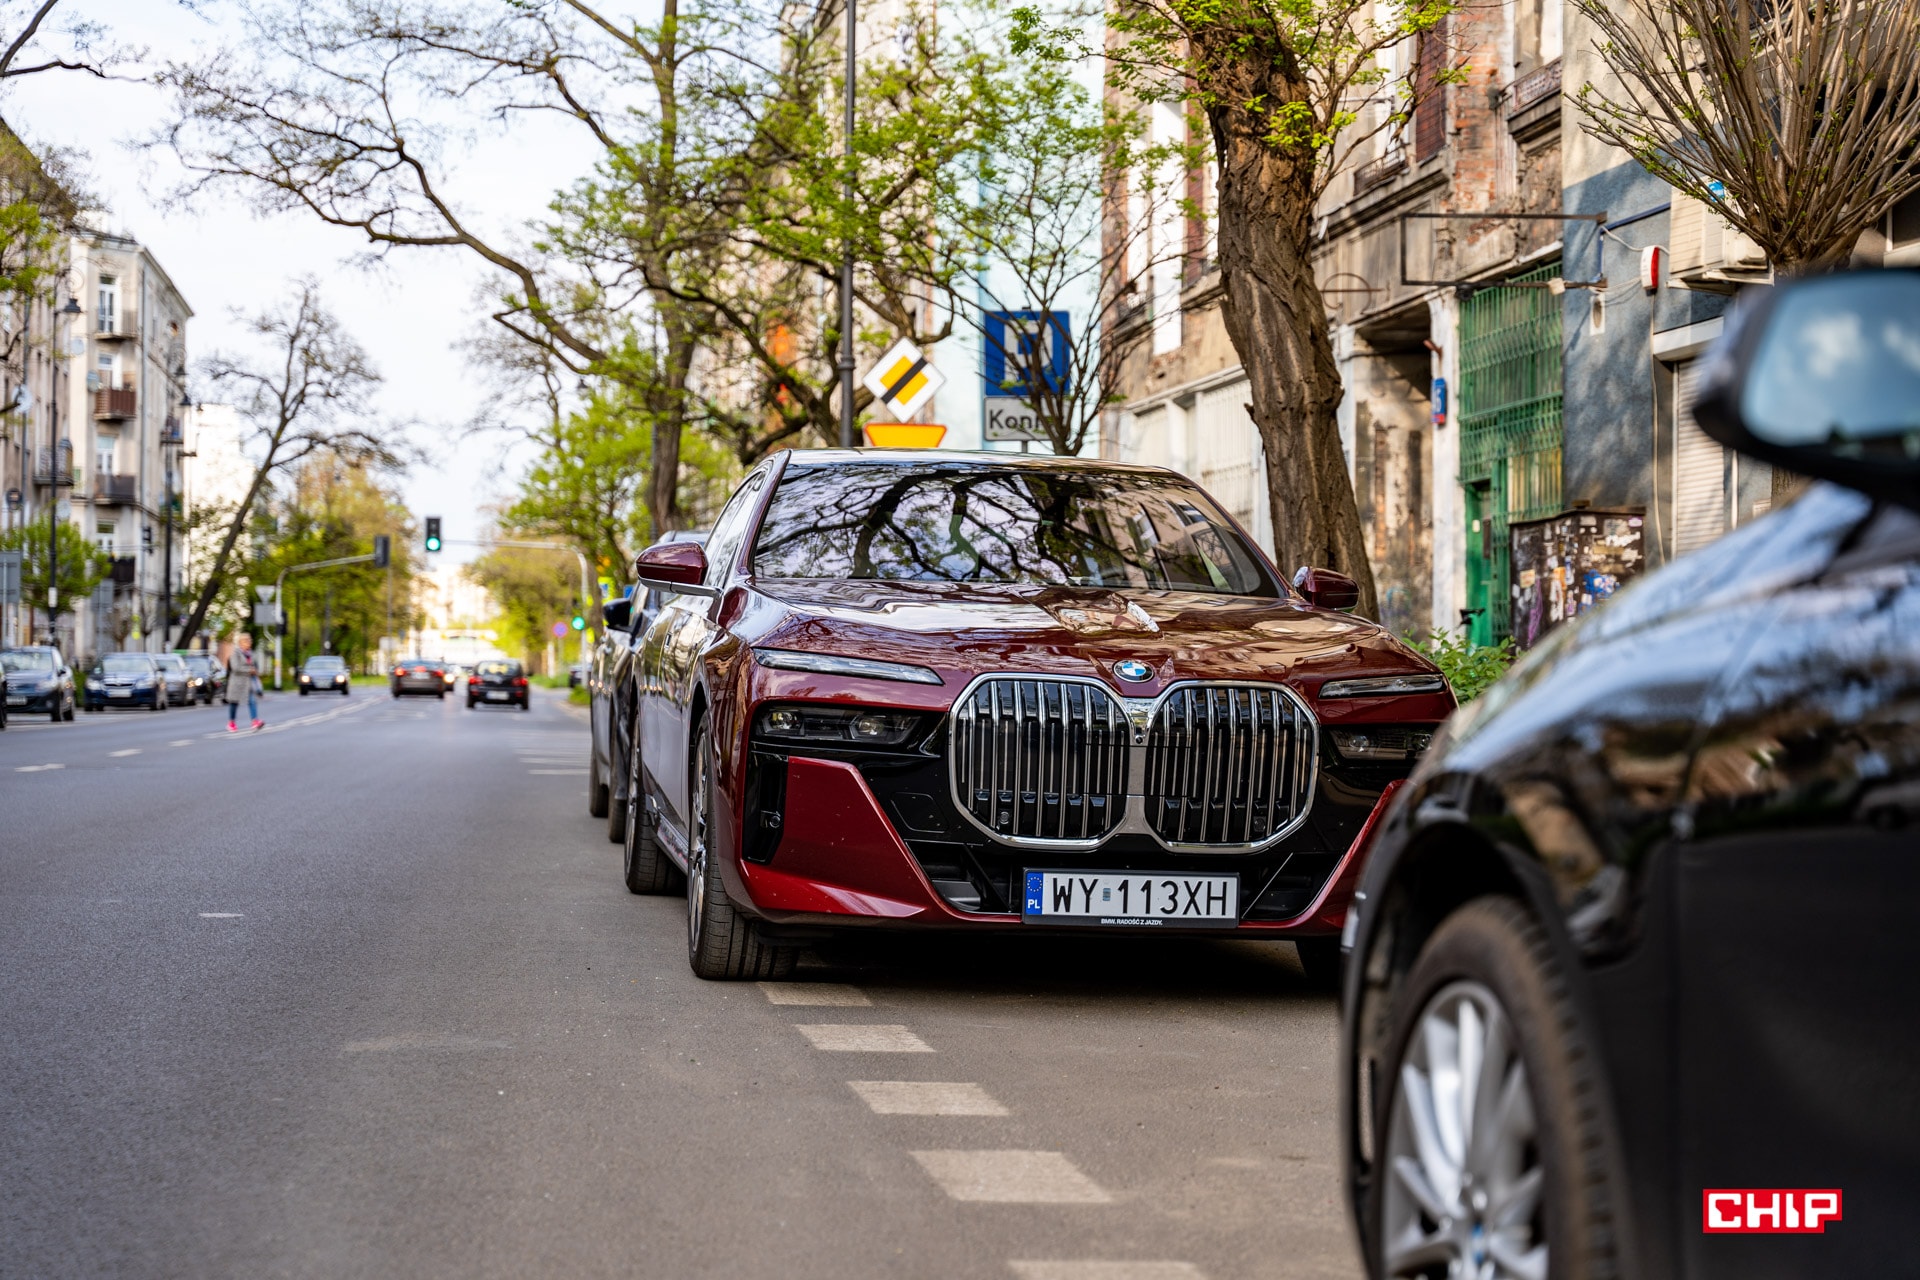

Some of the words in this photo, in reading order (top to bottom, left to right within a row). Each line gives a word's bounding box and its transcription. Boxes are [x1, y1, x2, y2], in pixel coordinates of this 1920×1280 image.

[1004, 319, 1053, 384] P
[1027, 899, 1041, 909] PL
[1052, 877, 1099, 914] WY
[1117, 879, 1228, 916] 113XH
